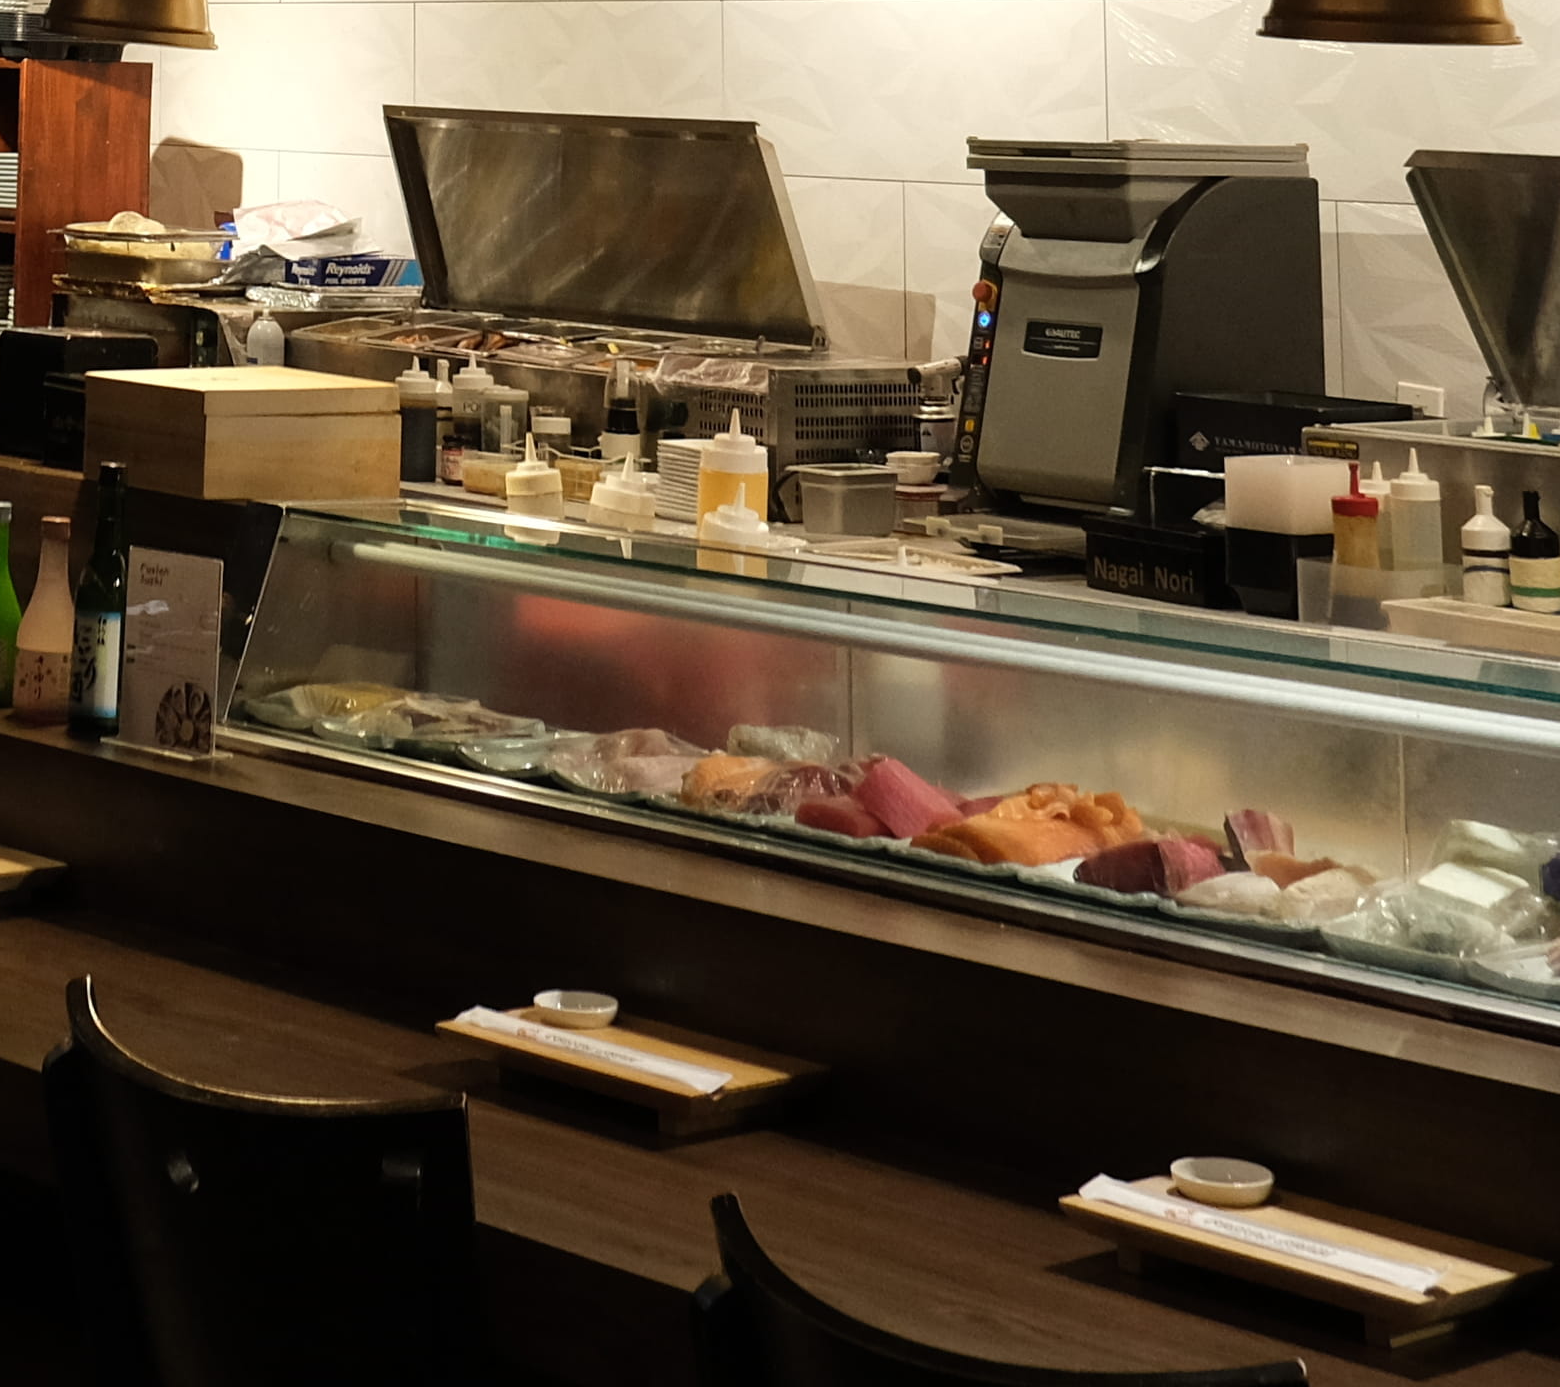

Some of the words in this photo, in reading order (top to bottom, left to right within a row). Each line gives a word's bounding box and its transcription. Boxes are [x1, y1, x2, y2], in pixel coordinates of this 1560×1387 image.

[326, 261, 372, 277] Reynolds
[1093, 555, 1144, 588] Nagai
[1154, 565, 1195, 595] Nori
